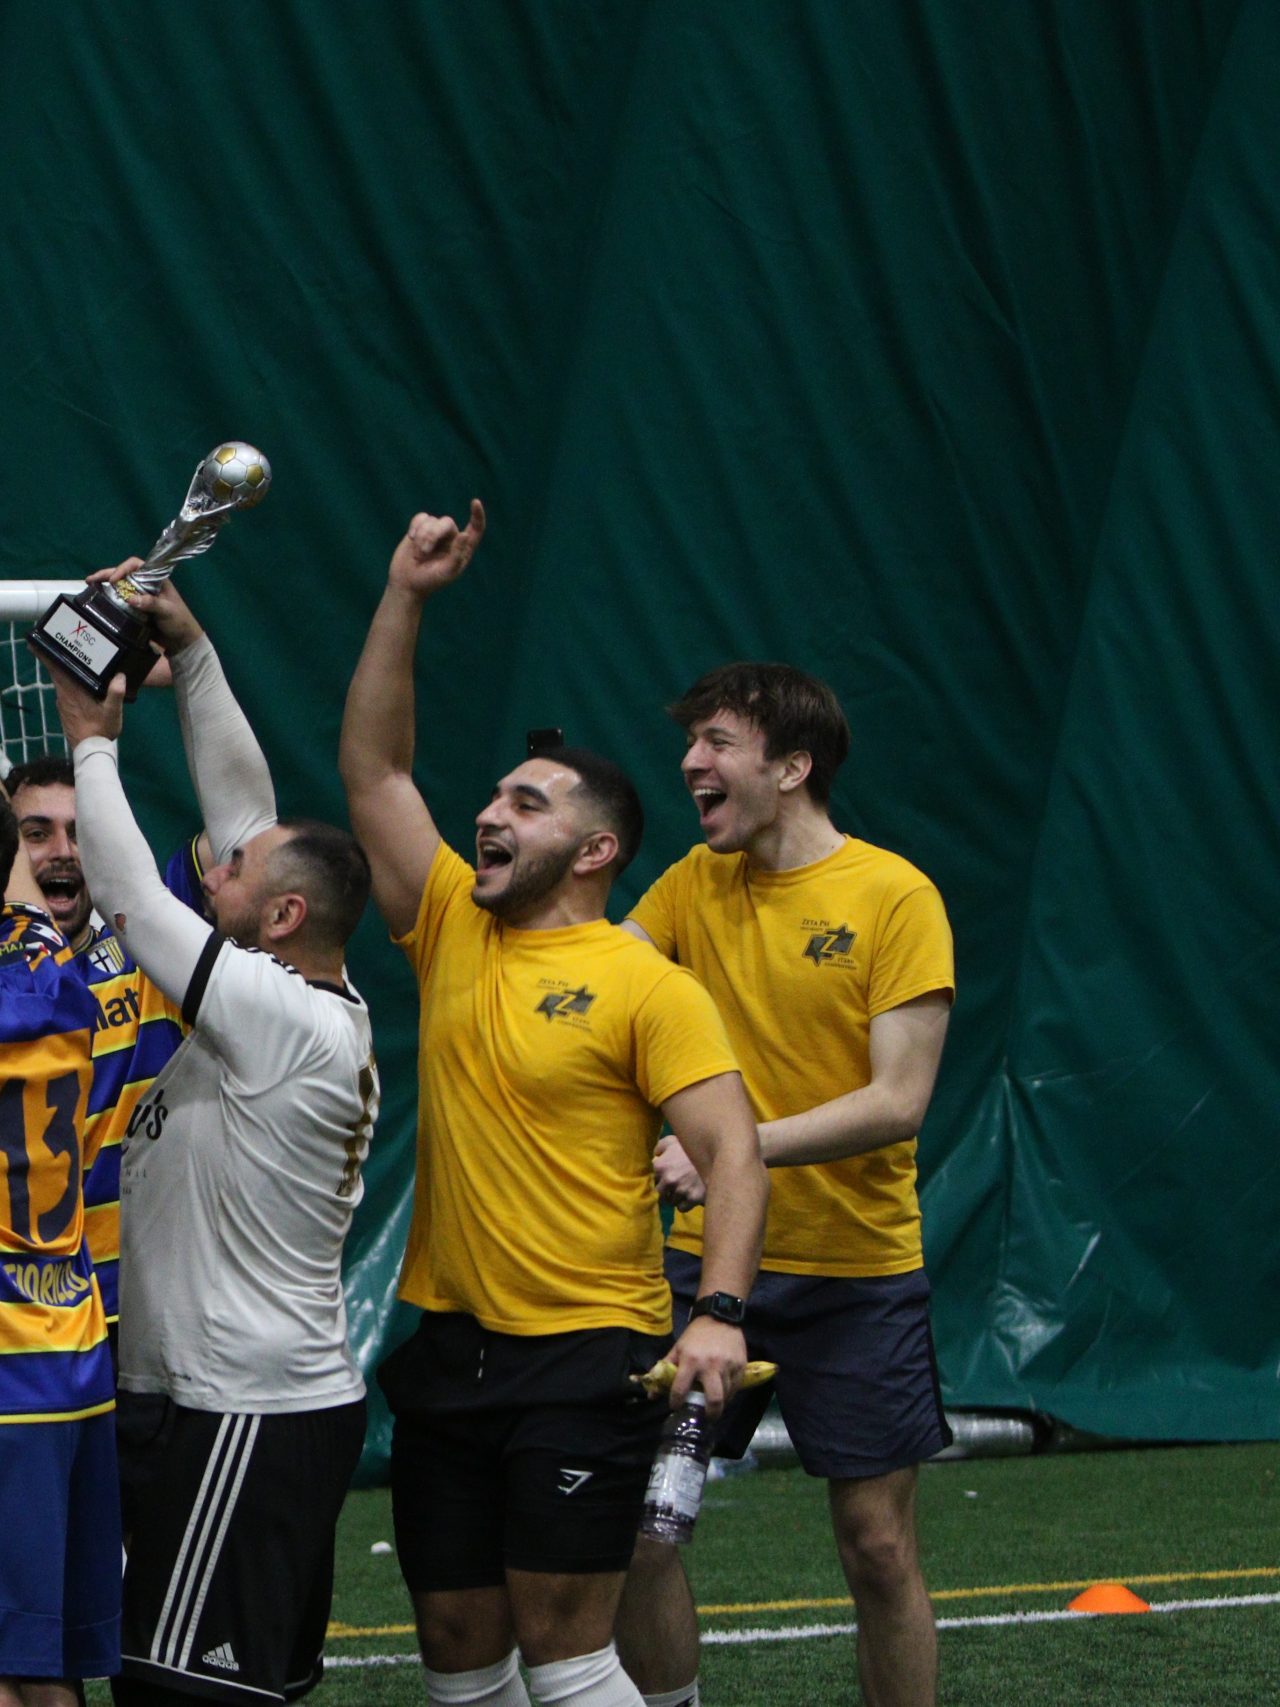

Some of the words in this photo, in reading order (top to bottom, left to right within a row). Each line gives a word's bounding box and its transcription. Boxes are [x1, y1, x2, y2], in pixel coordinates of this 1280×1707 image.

[54, 631, 93, 666] CHAMPIONS
[95, 987, 140, 1031] lat
[202, 1654, 240, 1672] adidas
